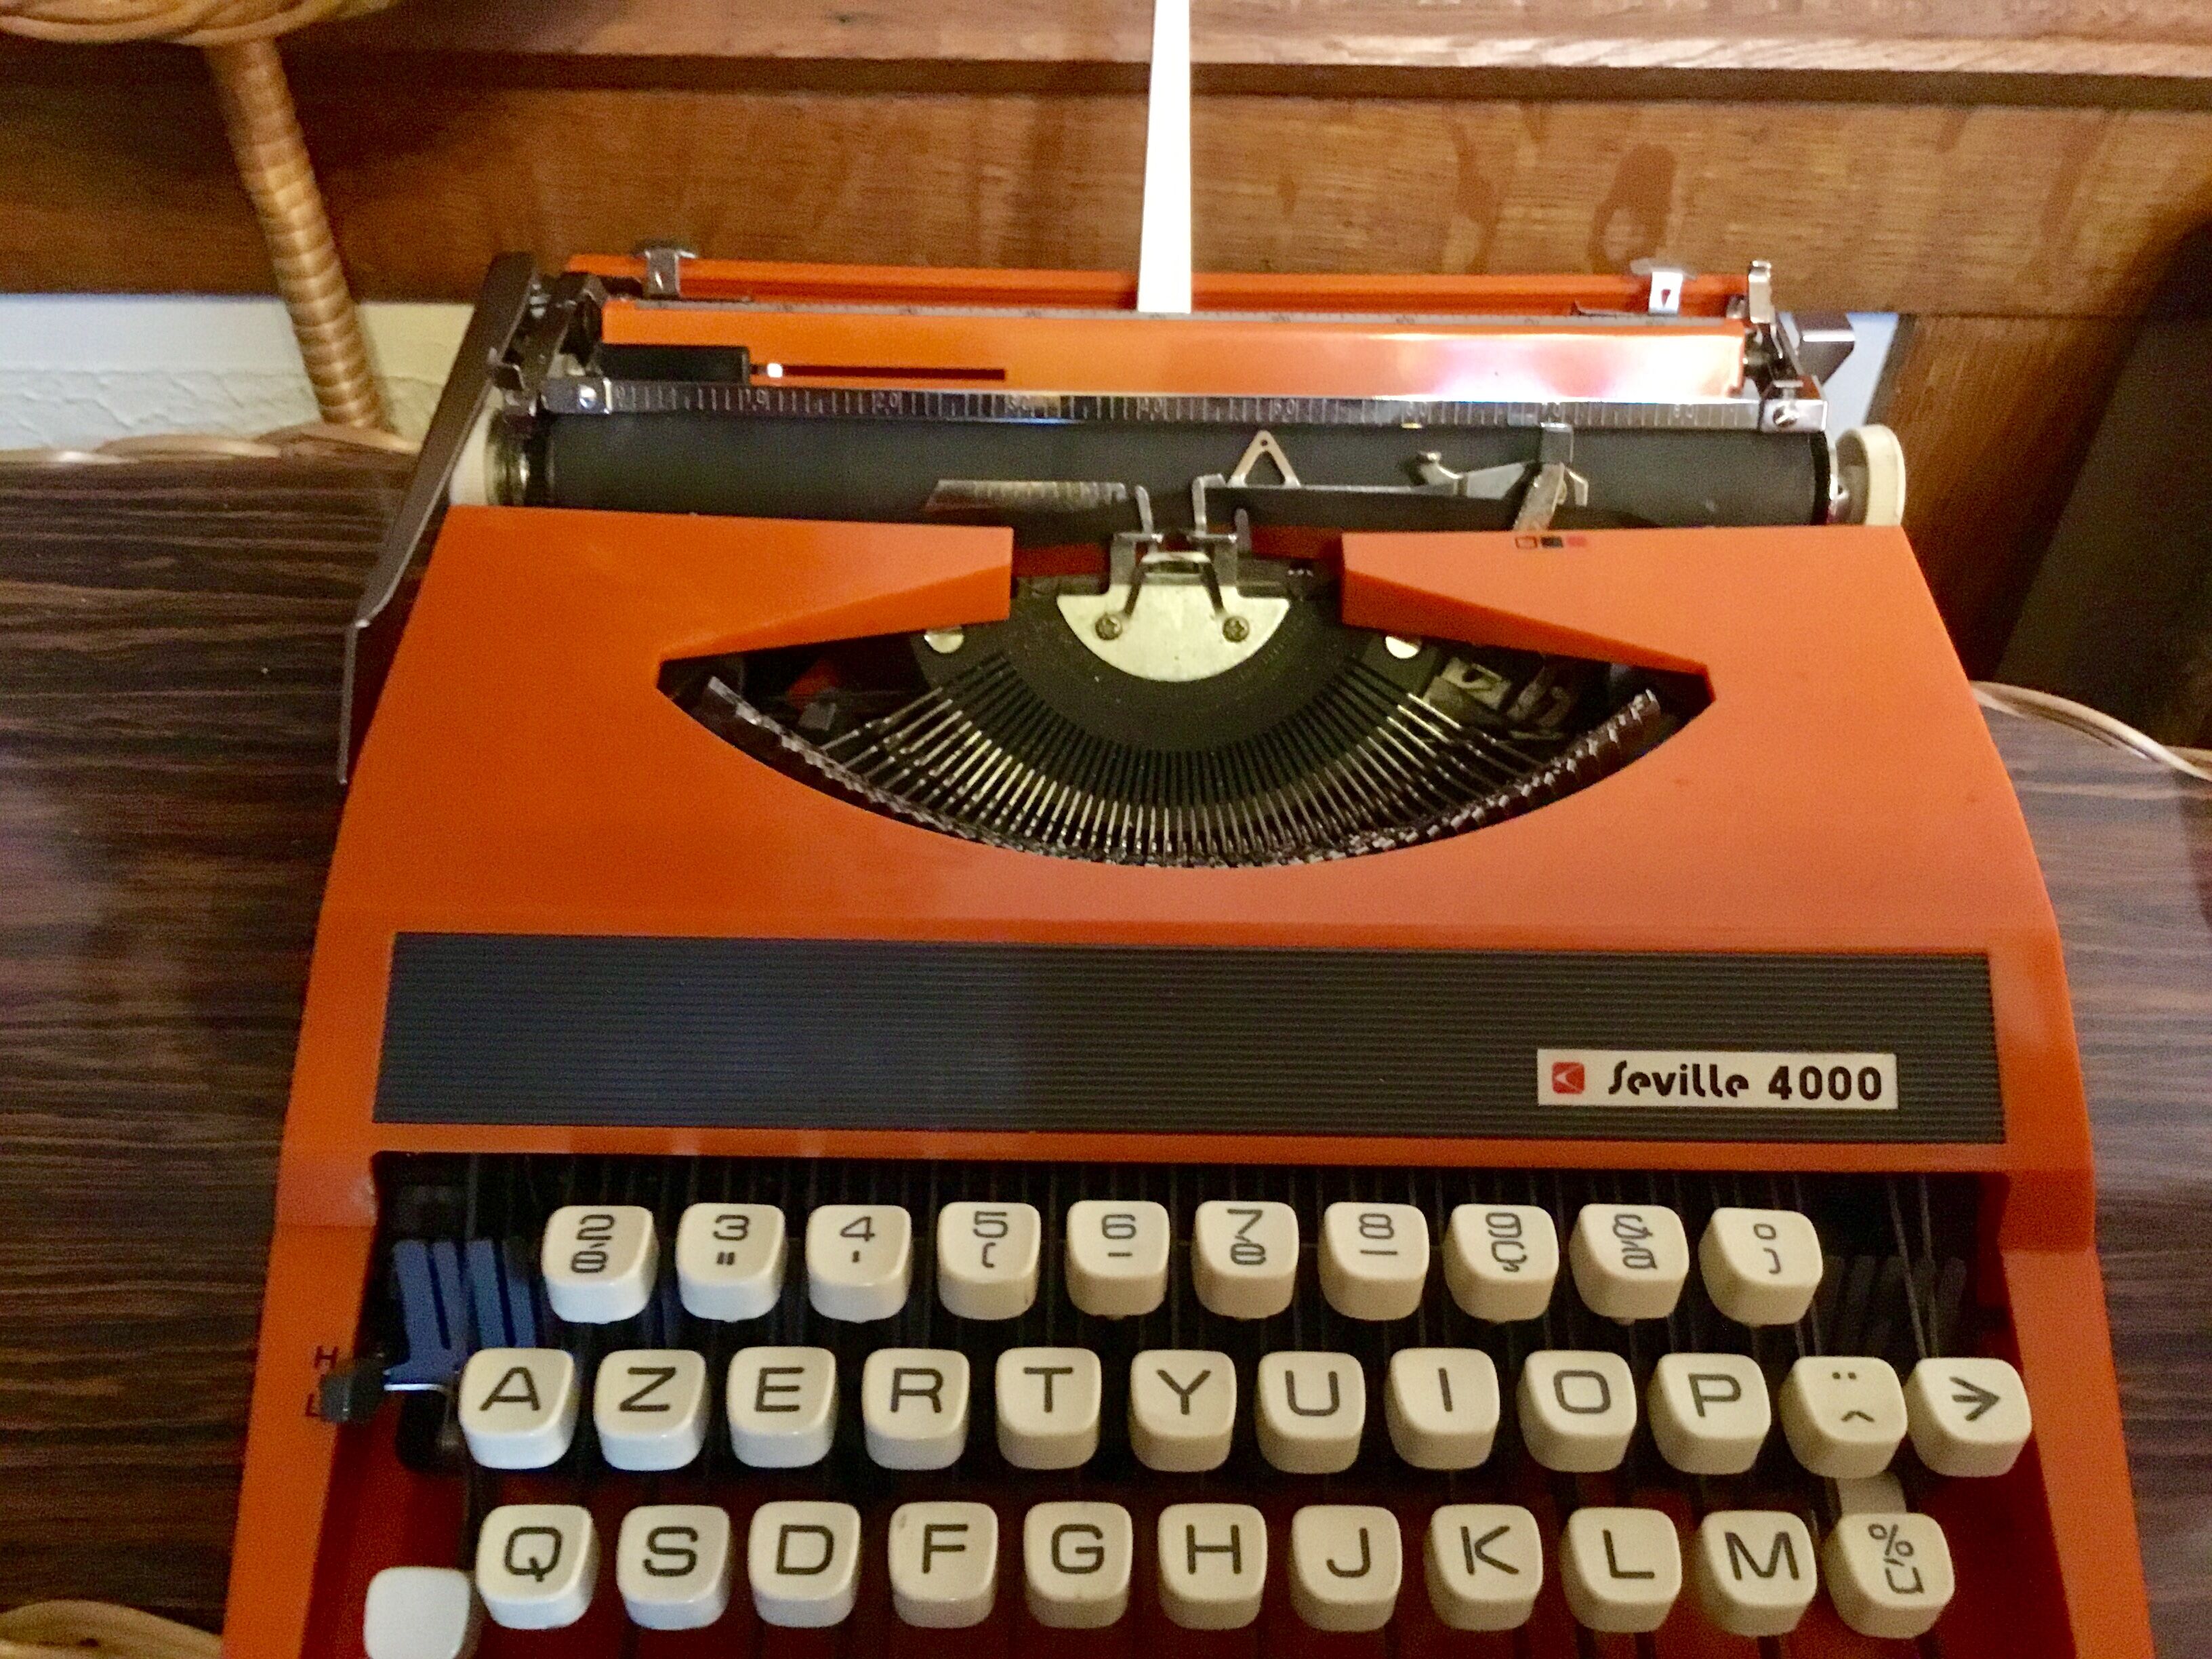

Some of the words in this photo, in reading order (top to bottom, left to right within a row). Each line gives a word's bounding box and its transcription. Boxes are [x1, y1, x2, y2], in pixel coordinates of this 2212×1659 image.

[1609, 1061, 1748, 1097] Seville
[1769, 1066, 1881, 1101] 4000
[577, 1214, 615, 1240] 2
[714, 1215, 750, 1241] 3
[840, 1216, 875, 1242] 4
[973, 1211, 1008, 1238] 5
[1102, 1214, 1136, 1240] 6
[1227, 1209, 1263, 1235] 7
[1359, 1214, 1394, 1240] 8
[1486, 1212, 1522, 1238] 9
[314, 1345, 339, 1369] H
[480, 1367, 540, 1411] A
[619, 1367, 676, 1412] Z
[755, 1367, 804, 1412] E
[891, 1368, 943, 1413] R
[1024, 1367, 1073, 1412] T
[1158, 1370, 1211, 1415] Y
[1286, 1371, 1340, 1416] U
[1439, 1368, 1452, 1412] I
[1554, 1370, 1611, 1414] O
[1688, 1374, 1741, 1417] P
[504, 1527, 562, 1582] Q
[644, 1526, 698, 1577] S
[777, 1525, 834, 1575] D
[922, 1524, 968, 1574] F
[1052, 1524, 1104, 1574] G
[1187, 1525, 1242, 1574] H
[1327, 1528, 1371, 1578] J
[1461, 1525, 1519, 1575] K
[1603, 1530, 1654, 1579] L
[1725, 1532, 1799, 1580] M
[1868, 1524, 1914, 1557] %
